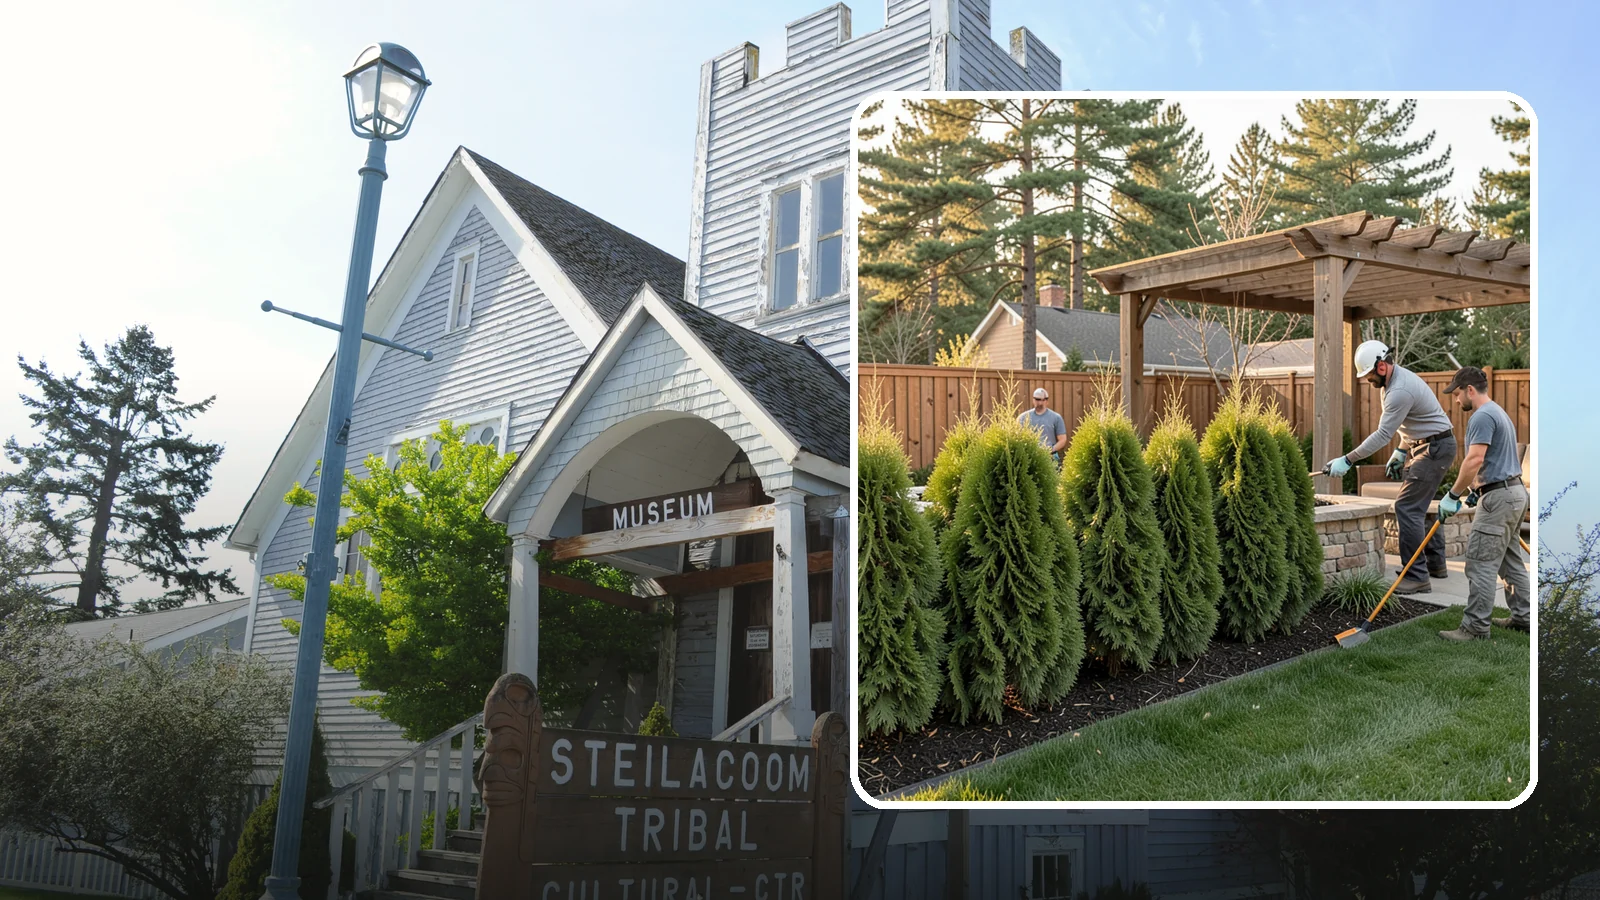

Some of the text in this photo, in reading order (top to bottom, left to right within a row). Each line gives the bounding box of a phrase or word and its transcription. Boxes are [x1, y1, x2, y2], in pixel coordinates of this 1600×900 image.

[613, 491, 714, 530] MUSEUM
[550, 738, 810, 793] STEILACOOM
[615, 806, 758, 852] TRIBAL
